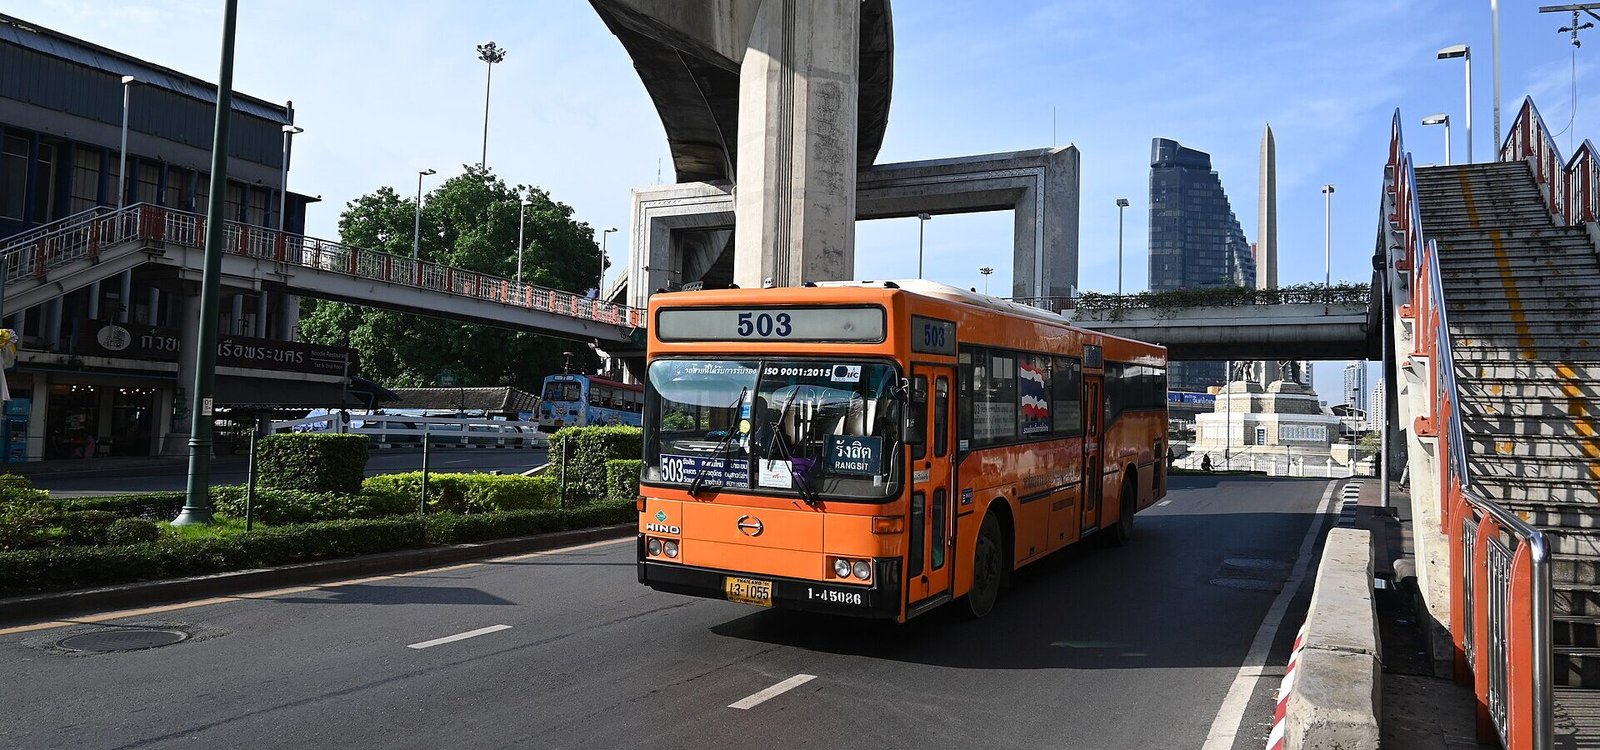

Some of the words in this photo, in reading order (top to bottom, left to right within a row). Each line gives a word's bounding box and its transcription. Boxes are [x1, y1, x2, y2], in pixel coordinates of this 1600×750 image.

[737, 312, 792, 337] 503
[924, 323, 945, 347] 503
[763, 367, 779, 375] ISO
[780, 367, 831, 377] 9001:2015
[835, 439, 872, 459] รังสิต
[661, 456, 684, 483] 503
[834, 460, 869, 471] RANGSIT
[646, 523, 680, 534] HINO
[807, 587, 862, 605] 1-45086
